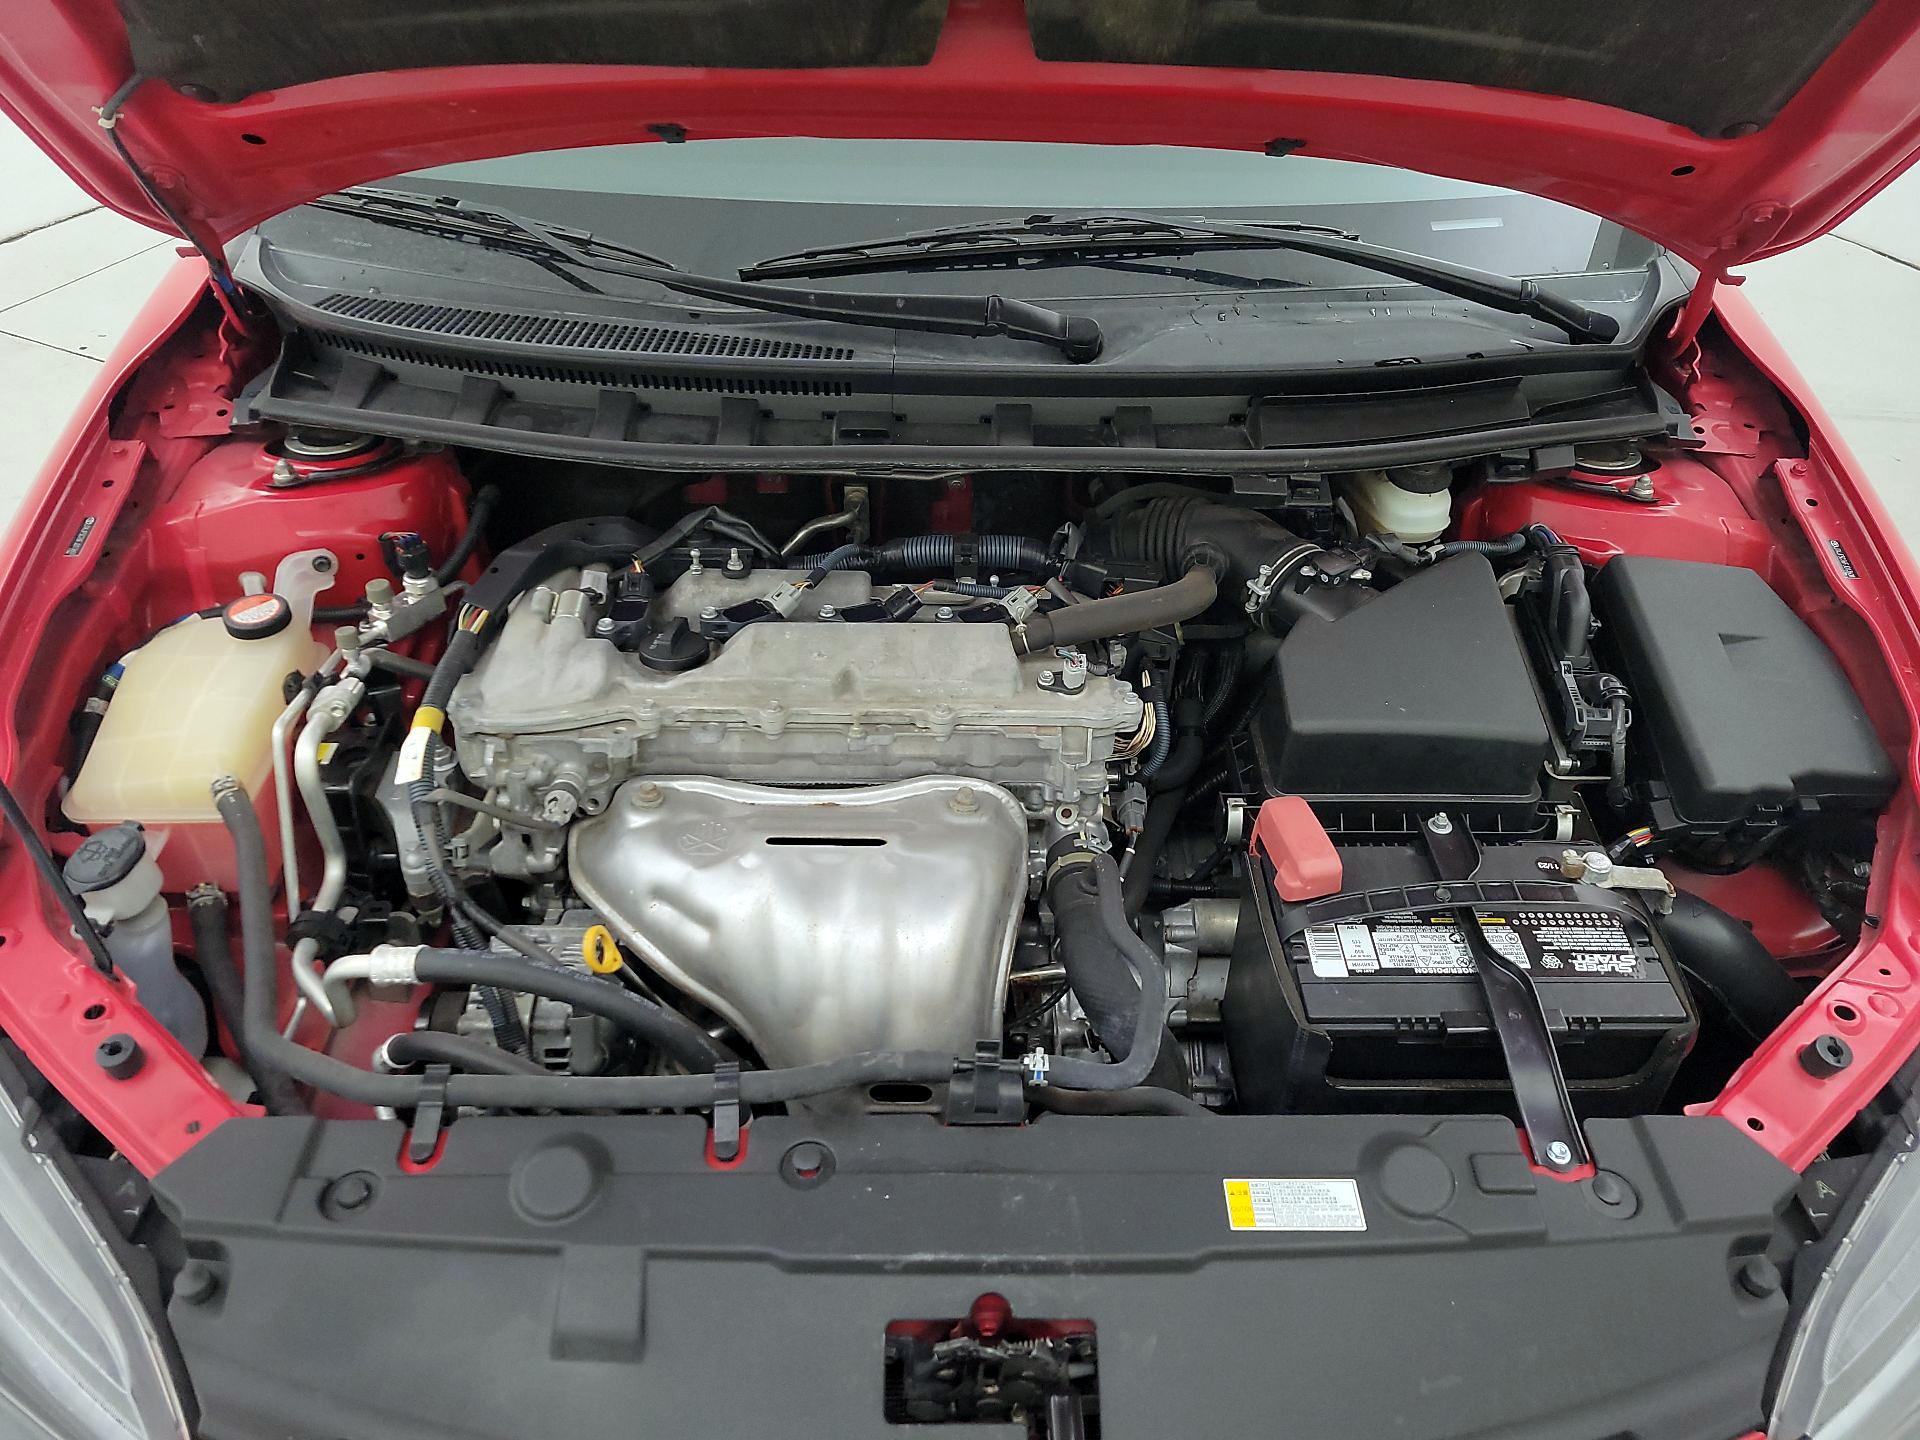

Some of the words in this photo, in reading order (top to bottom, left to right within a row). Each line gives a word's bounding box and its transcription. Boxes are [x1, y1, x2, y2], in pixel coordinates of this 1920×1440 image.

[1537, 861, 1560, 870] 11/23
[1573, 954, 1637, 964] START
[1574, 962, 1633, 973] SUPER
